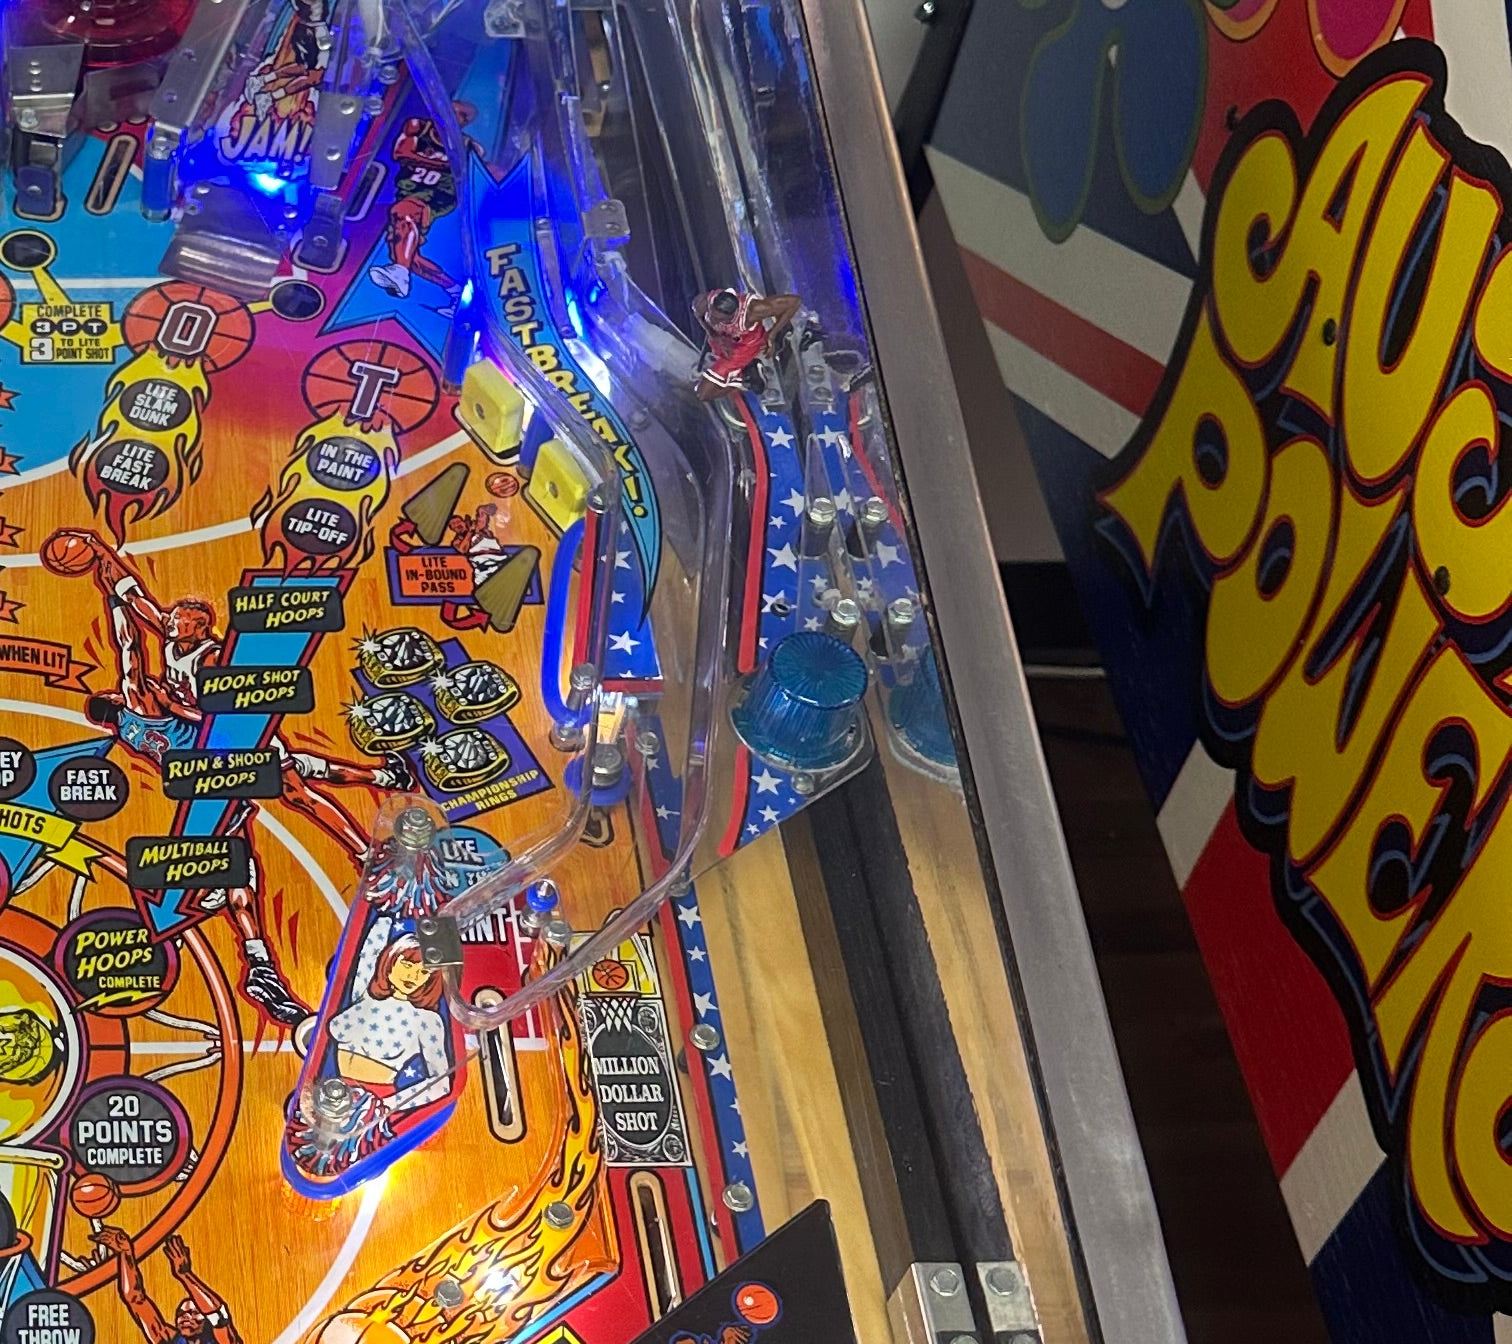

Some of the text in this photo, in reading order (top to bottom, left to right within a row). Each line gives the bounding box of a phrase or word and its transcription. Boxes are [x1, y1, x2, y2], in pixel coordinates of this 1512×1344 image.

[37, 304, 102, 318] COMPLETE
[145, 382, 178, 400] LITE
[349, 360, 399, 420] T
[135, 394, 177, 414] SLAM
[129, 407, 170, 427] DUNK
[121, 442, 156, 460] LITE
[321, 444, 374, 470] IN THE
[113, 453, 153, 474] FAST
[314, 455, 366, 482] PAINT
[100, 467, 152, 491] BREAK
[306, 507, 341, 527] LITE
[287, 519, 348, 548] TIP-OFF
[421, 557, 449, 569] LITE
[405, 568, 468, 583] IN-BOUND
[420, 580, 456, 594] PASS
[235, 589, 330, 613] HALF COURT
[265, 607, 325, 629] HOOPS
[40, 647, 65, 667] LIT
[202, 669, 301, 694] HOOK SHOT
[234, 685, 295, 709] HOOPS
[168, 752, 272, 779] RUN SHOOT
[66, 770, 110, 785] FAST
[194, 770, 256, 794] HOOPS
[60, 785, 117, 802] BREAK
[441, 769, 539, 814] CHAMPIONSHIP
[475, 790, 518, 811] RINGS
[138, 842, 230, 867] MULTIBALL
[165, 858, 230, 882] HOOPS
[75, 928, 148, 955] POWER
[77, 947, 153, 980] HOOPS
[98, 975, 160, 989] COMPLETE
[593, 1056, 659, 1076] MILLION
[600, 1084, 664, 1102] DOLLAR
[109, 1096, 140, 1117] 20
[614, 1111, 658, 1132] SHOT
[77, 1121, 173, 1145] POINTS
[87, 1148, 162, 1165] COMPLETE
[28, 1305, 69, 1327] FREE
